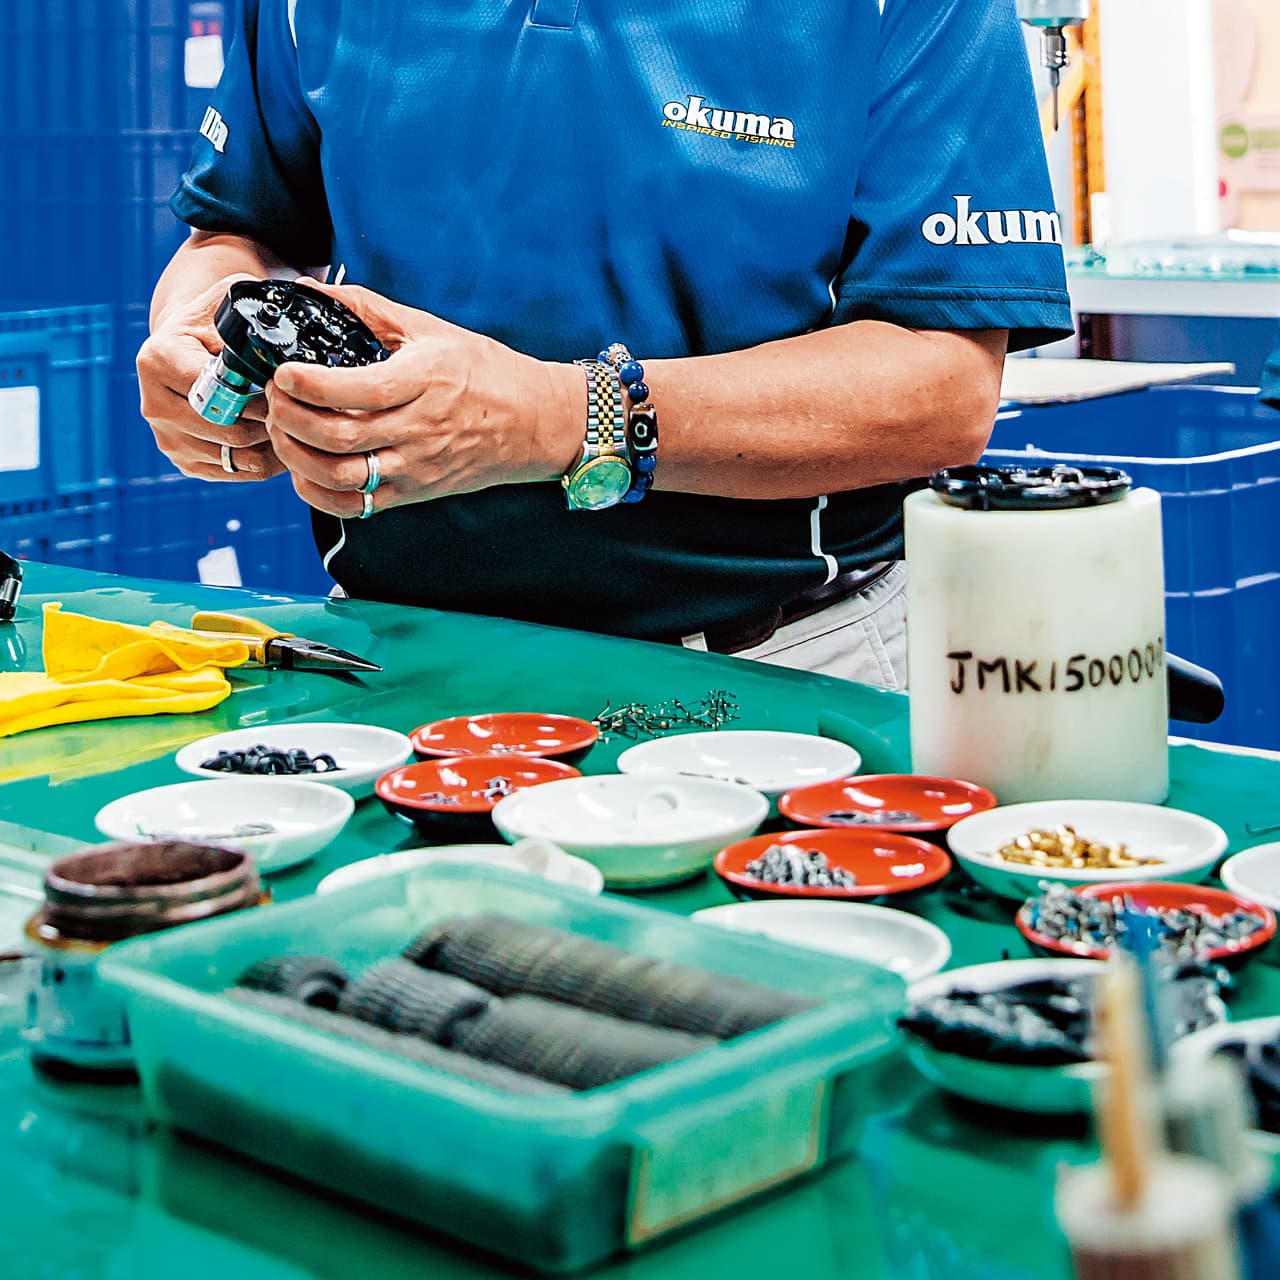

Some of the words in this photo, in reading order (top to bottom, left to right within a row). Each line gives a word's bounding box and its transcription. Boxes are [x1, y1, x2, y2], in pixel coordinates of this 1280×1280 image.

[661, 119, 732, 140] INSPIRED
[735, 132, 797, 149] FISHING
[662, 94, 796, 141] okuma
